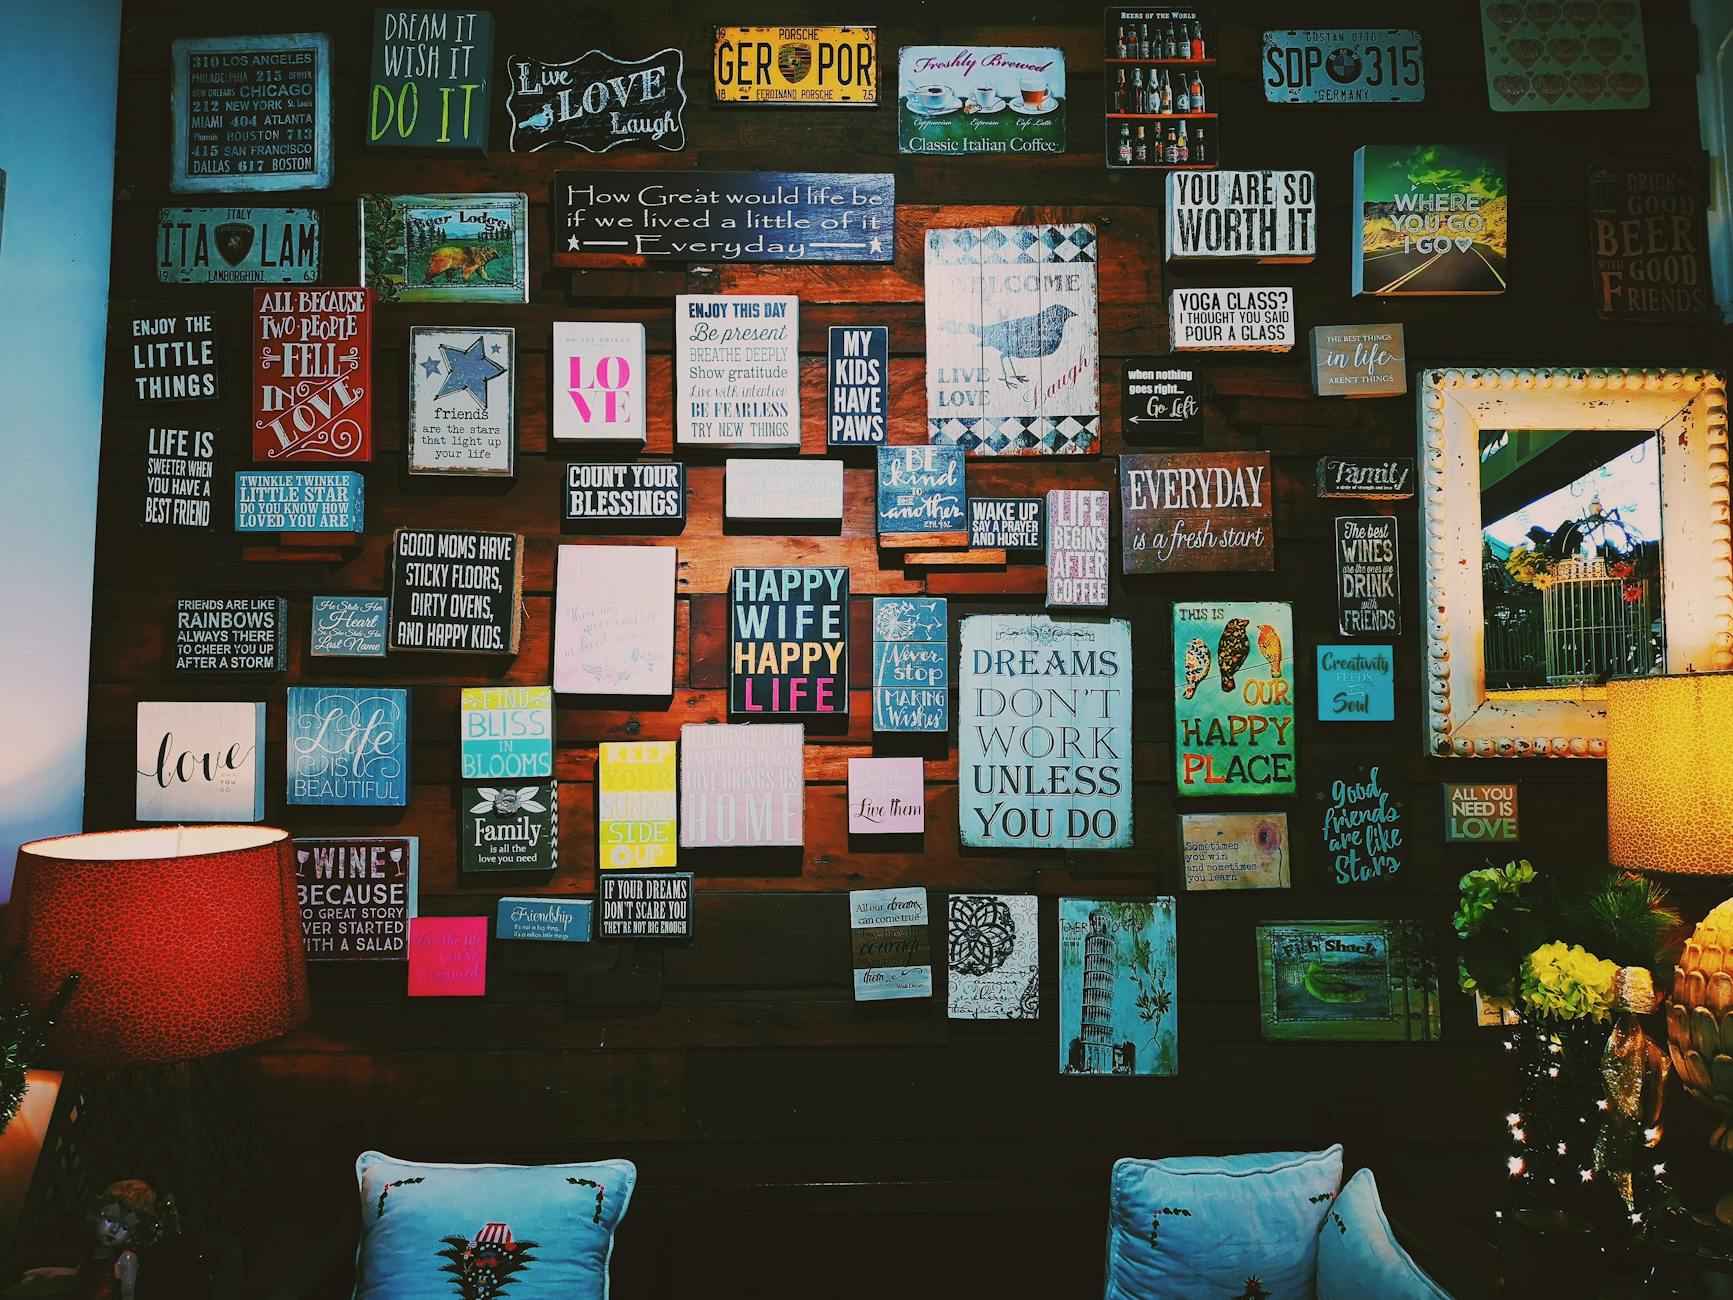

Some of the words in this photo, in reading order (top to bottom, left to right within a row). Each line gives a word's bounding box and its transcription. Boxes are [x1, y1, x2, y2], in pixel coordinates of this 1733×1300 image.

[385, 13, 447, 41] DREAM
[454, 14, 478, 42] IT
[384, 43, 440, 79] WISH
[449, 45, 475, 79] IT
[719, 43, 772, 85] GER
[818, 43, 872, 86] POR
[1267, 46, 1321, 88] SDP
[1365, 46, 1421, 87] 315
[515, 63, 573, 95] Live
[556, 66, 666, 123] LOVE
[1318, 90, 1370, 100] GERMANY
[370, 82, 418, 141] DO
[435, 84, 480, 143] IT
[609, 112, 679, 141] Laugh
[909, 137, 959, 151] Classic
[963, 137, 1006, 151] Italian
[1010, 138, 1057, 151] Coffee
[193, 159, 230, 173] DALLAS
[238, 159, 263, 171] 617
[272, 157, 312, 171] BOSTON
[567, 184, 631, 206] How
[638, 185, 721, 206] Great
[726, 186, 799, 205] would
[807, 186, 844, 205] life
[852, 186, 883, 205] be
[1177, 174, 1219, 206] YOU
[1231, 173, 1274, 205] ARE
[1283, 173, 1312, 205] SO
[1394, 193, 1481, 212] WHERE
[1177, 208, 1277, 251] WORTH
[1288, 208, 1313, 251] IT
[1390, 214, 1440, 233] YOU
[1447, 213, 1483, 232] GO
[1592, 216, 1697, 256] BEER
[160, 222, 209, 267] ITA
[261, 223, 316, 267] LAM
[634, 234, 806, 260] Everyday
[1629, 255, 1697, 288] GOOD
[259, 292, 293, 313] ALL
[299, 290, 366, 313] BECAUSE
[689, 303, 728, 318] ENJOY
[732, 303, 760, 318] THIS
[764, 303, 787, 318] DAY
[1180, 293, 1221, 310] YOGA
[1227, 292, 1288, 310] CLASS?
[133, 318, 176, 336] ENJOY
[185, 315, 212, 333] THE
[134, 340, 214, 368] LITTLE
[844, 331, 872, 356] MY
[281, 343, 341, 378] FELL
[1327, 350, 1349, 369] in
[1353, 342, 1393, 376] life
[836, 360, 880, 385] KIDS
[936, 368, 990, 383] LIVE
[1022, 344, 1089, 408] Laugh
[1128, 370, 1154, 380] when
[1156, 370, 1192, 381] nothing
[135, 373, 215, 399] THINGS
[936, 389, 990, 407] LOVE
[271, 376, 354, 450] LOVE
[834, 387, 881, 413] HAVE
[434, 407, 489, 420] friends
[832, 416, 884, 441] PAWS
[149, 428, 189, 457] LIFE
[195, 431, 214, 458] IS
[148, 458, 186, 476] SWEETER
[188, 460, 213, 478] WHEN
[906, 448, 938, 472] BE
[239, 476, 293, 486] TWINKLE
[296, 476, 350, 486] TWINKLE
[570, 466, 627, 487] COUNT
[631, 466, 678, 487] YOUR
[1128, 466, 1265, 510] EVERYDAY
[1327, 462, 1409, 490] Family
[239, 487, 299, 502] LITTLE
[304, 487, 349, 502] STAR
[570, 491, 678, 516] BLESSINGS
[145, 497, 172, 524] BEST
[173, 498, 211, 527] FRIEND
[239, 515, 285, 528] LOVED
[289, 515, 316, 528] YOU
[319, 515, 349, 528] ARE
[973, 503, 1014, 520] WAKE
[1019, 503, 1038, 520] UP
[1058, 492, 1102, 526] LIFE
[400, 532, 434, 557] GOOD
[438, 534, 477, 560] MOMS
[479, 535, 513, 561] HAVE
[972, 533, 995, 546] AND
[999, 533, 1038, 546] HUSTLE
[1055, 526, 1105, 550] BEGINS
[1054, 551, 1105, 578] AFTER
[1341, 540, 1394, 563] WINES
[406, 563, 449, 588] STICKY
[452, 564, 502, 594] FLOORS,
[735, 569, 844, 602] HAPPY
[1054, 578, 1106, 602] COFFEE
[1343, 574, 1395, 598] DRINK
[177, 612, 274, 629] RAINBOWS
[319, 611, 378, 629] Heart
[411, 592, 448, 617] DIRTY
[450, 594, 494, 623] OVENS,
[1344, 609, 1396, 632] FRIENDS
[735, 604, 841, 639] WIFE
[177, 630, 229, 642] ALWAYS
[233, 630, 275, 642] THERE
[398, 621, 423, 646] AND
[427, 622, 471, 648] HAPPY
[472, 624, 504, 649] KIDS.
[735, 641, 844, 674] HAPPY
[973, 649, 1119, 676] DREAMS
[894, 663, 944, 685] stop
[745, 678, 834, 711] LIFE
[885, 690, 944, 706] MAKING
[972, 688, 1121, 718] DON'T
[1242, 680, 1292, 705] OUR
[1327, 691, 1369, 714] Soul
[467, 710, 546, 737] BLISS
[1180, 715, 1292, 747] HAPPY
[976, 725, 1119, 760] WORK
[138, 732, 255, 788] love
[463, 753, 550, 777] BLOOMS
[1183, 753, 1293, 785] PLACE
[295, 780, 399, 799] BEAUTIFUL
[972, 764, 1121, 796] UNLESS
[1452, 787, 1479, 801] ALL
[1482, 787, 1513, 801] YOU
[688, 793, 799, 841] HOME
[858, 797, 886, 822] Live
[888, 798, 921, 816] them
[973, 801, 1053, 838] YOU
[1066, 808, 1117, 838] DO
[1452, 801, 1494, 817] NEED
[1499, 802, 1513, 816] IS
[474, 817, 541, 847] Family
[1328, 829, 1362, 851] are
[1365, 820, 1402, 856] like
[1452, 818, 1518, 839] LOVE
[1185, 841, 1239, 851] Sometimes
[313, 847, 385, 879] WINE
[510, 905, 573, 932] Friendship
[604, 901, 632, 919] DON'T
[635, 901, 665, 919] SCARE
[668, 901, 687, 919] YOU
[1324, 938, 1377, 956] Shack
